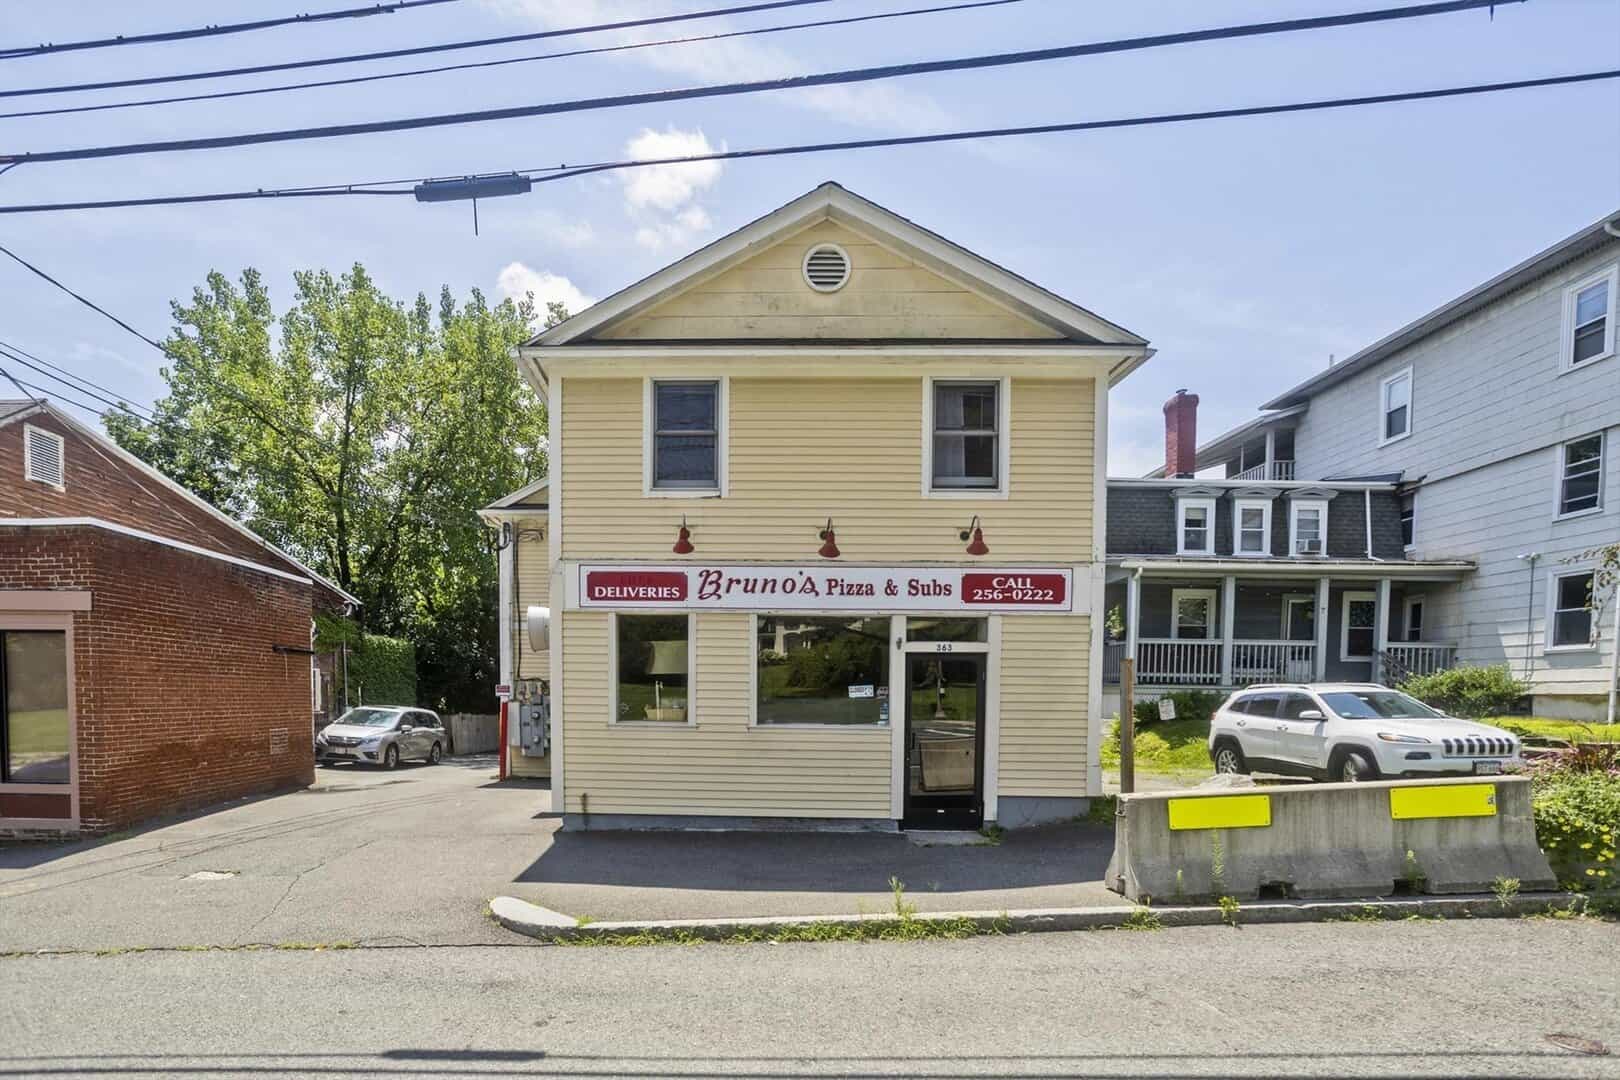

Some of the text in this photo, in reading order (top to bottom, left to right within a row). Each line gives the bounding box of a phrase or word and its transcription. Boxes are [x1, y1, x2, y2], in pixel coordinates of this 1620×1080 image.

[698, 569, 952, 600] Bruno's Pizza & Subs
[992, 577, 1034, 589] CALL
[594, 586, 680, 598] DELIVERIES
[973, 589, 1054, 600] 256-0222
[936, 643, 952, 651] 363
